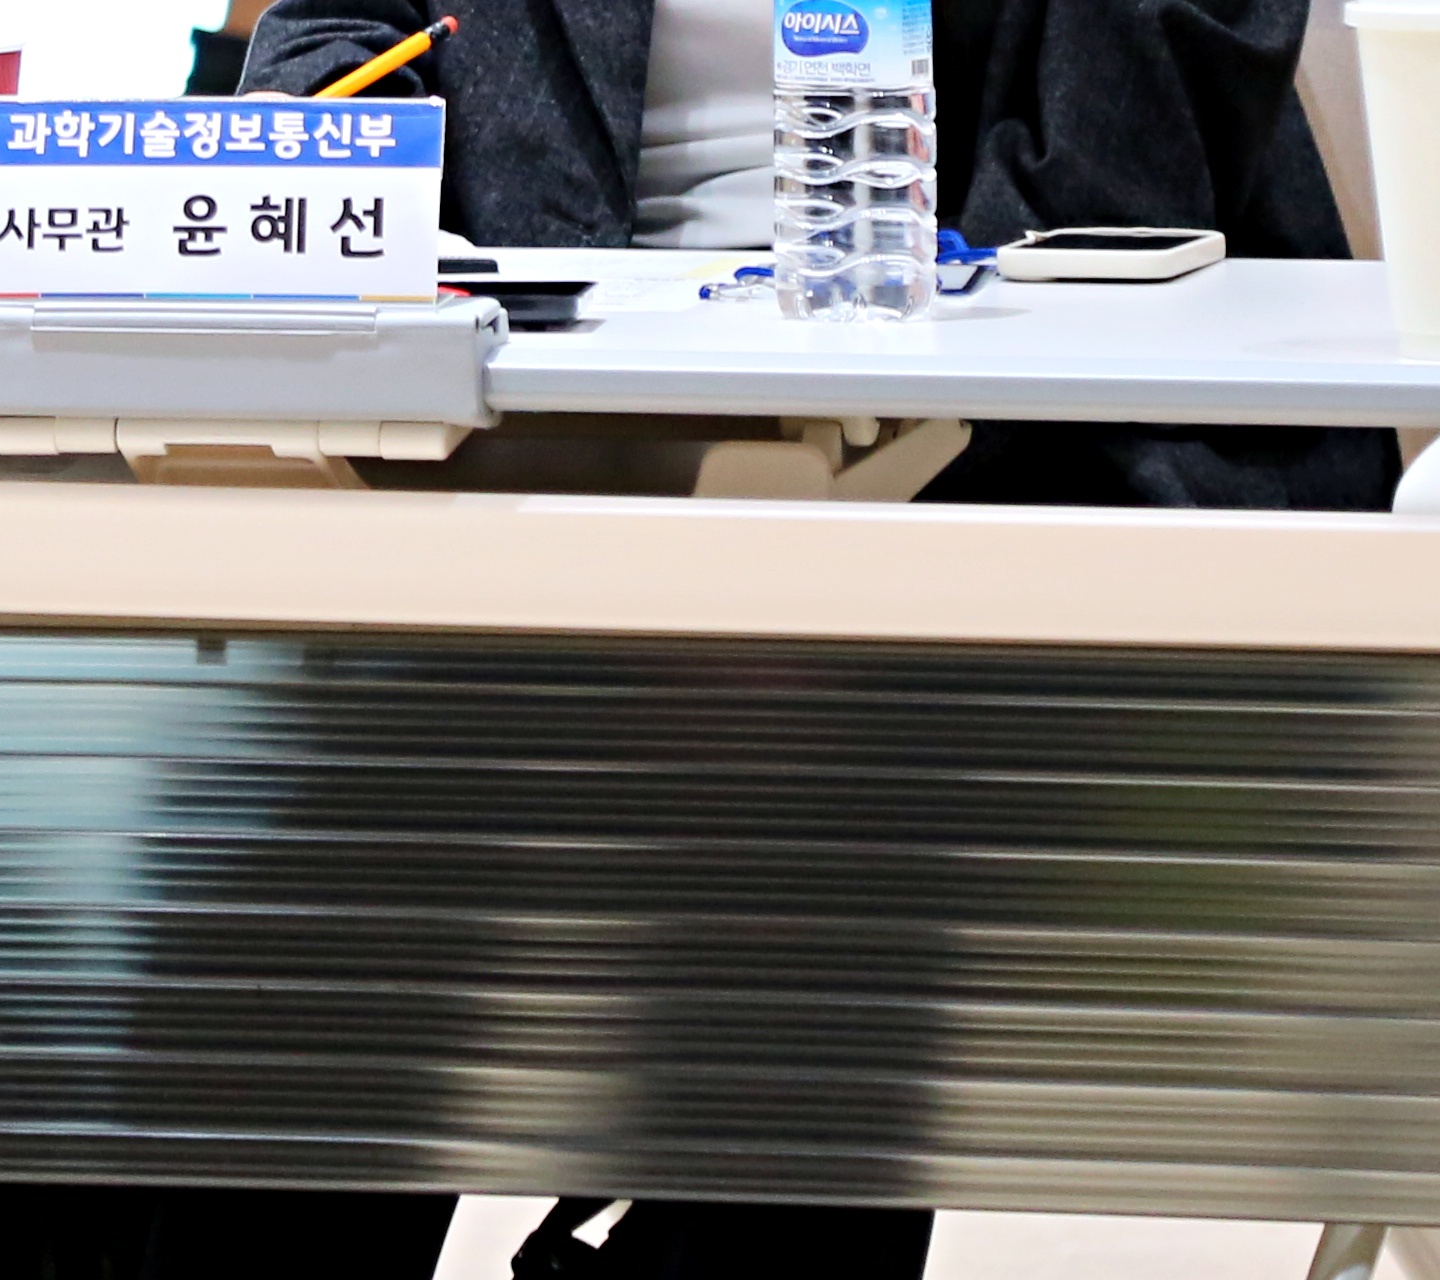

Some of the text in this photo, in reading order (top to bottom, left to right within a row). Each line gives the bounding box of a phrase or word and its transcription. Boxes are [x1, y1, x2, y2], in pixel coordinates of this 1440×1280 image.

[784, 12, 860, 34] 아이시스
[7, 111, 397, 160] 과학기술정보통신부
[172, 193, 386, 259] 윤혜선
